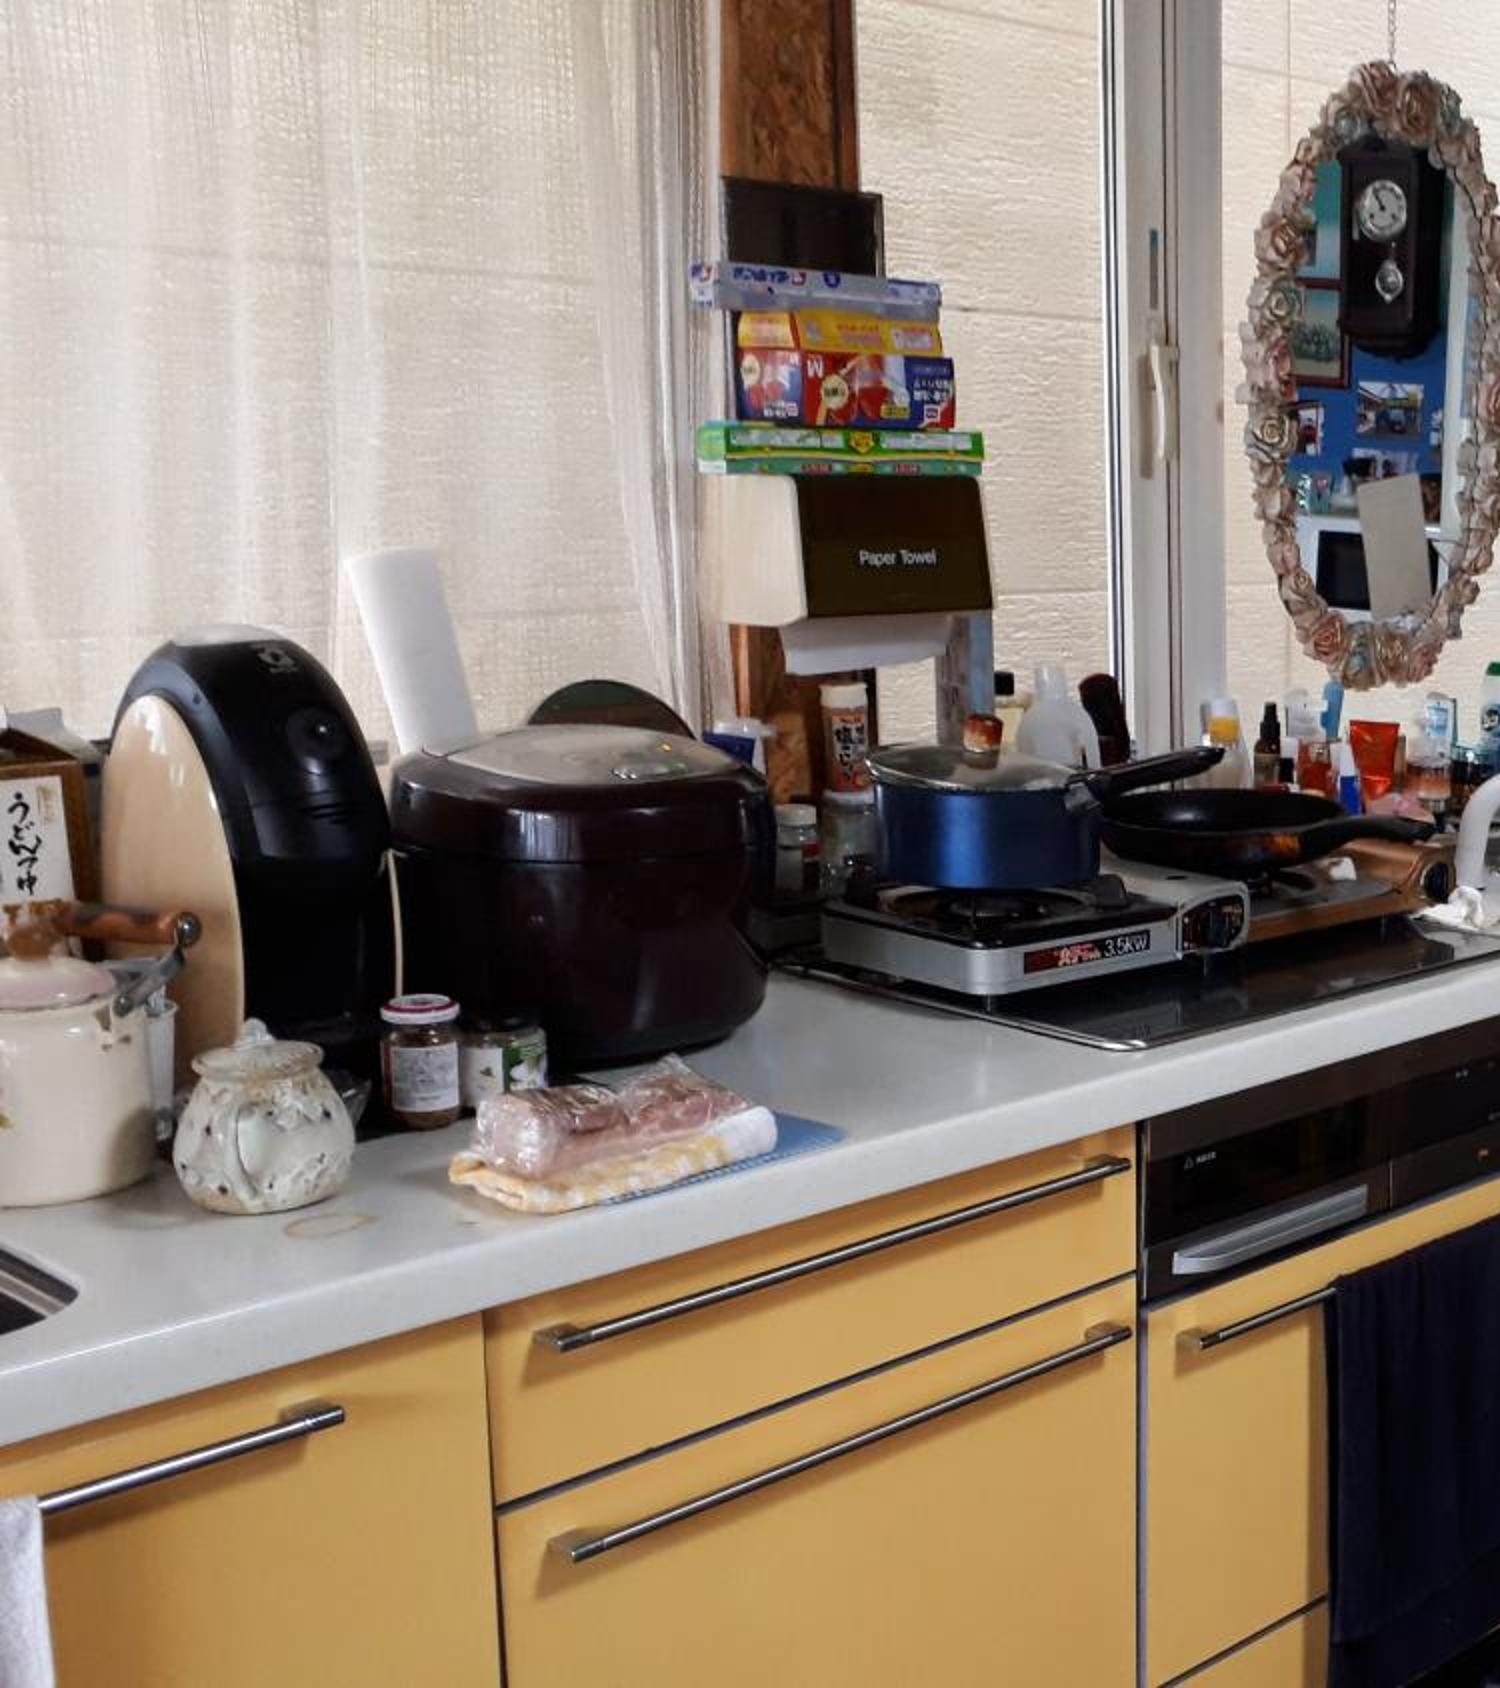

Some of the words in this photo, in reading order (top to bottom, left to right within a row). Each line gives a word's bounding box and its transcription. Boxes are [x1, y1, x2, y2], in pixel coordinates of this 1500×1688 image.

[860, 549, 896, 568] Paper
[900, 548, 937, 567] Towel
[8, 792, 42, 896] うどんつゆ
